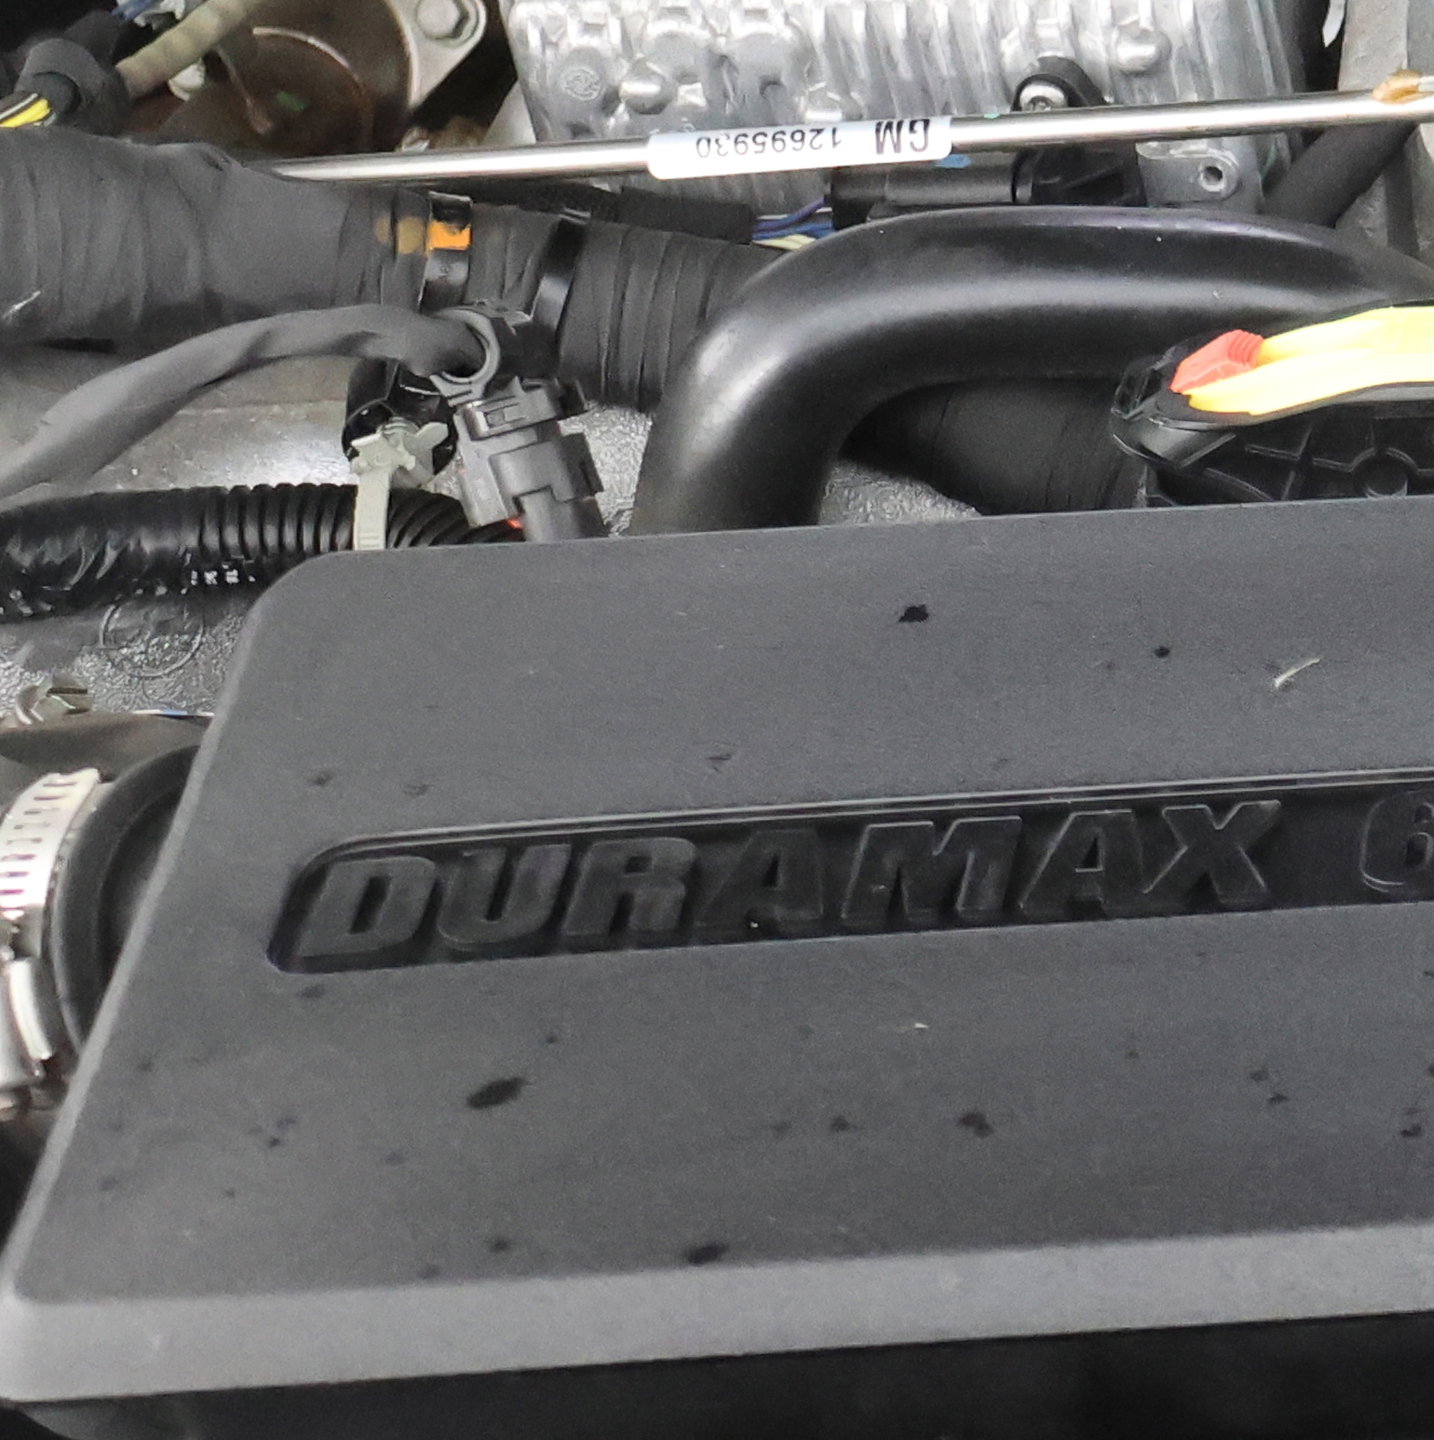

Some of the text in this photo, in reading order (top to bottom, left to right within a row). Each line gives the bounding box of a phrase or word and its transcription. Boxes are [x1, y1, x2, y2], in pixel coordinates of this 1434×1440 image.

[695, 117, 931, 160] GM 12695930
[296, 797, 1282, 964] DURAMAX
